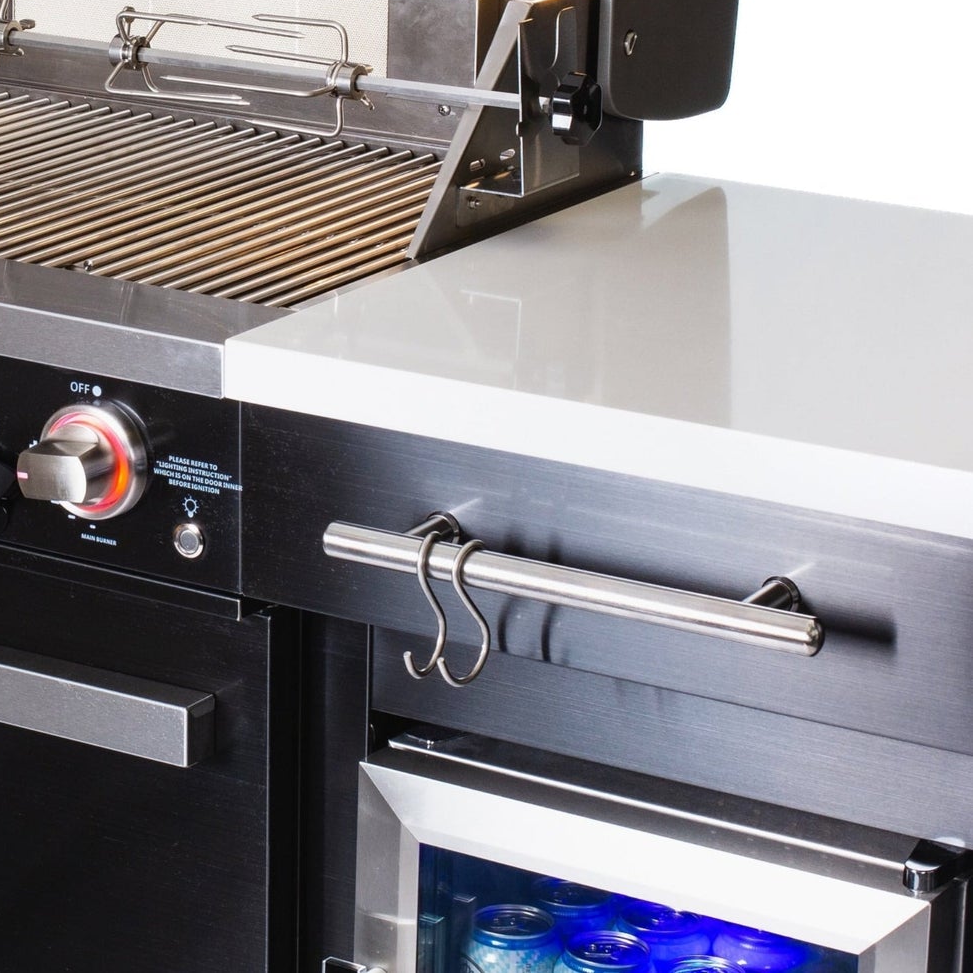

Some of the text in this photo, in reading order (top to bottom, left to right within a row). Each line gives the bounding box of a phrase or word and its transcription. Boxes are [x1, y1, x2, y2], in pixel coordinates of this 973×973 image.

[70, 382, 90, 394] OFF
[169, 456, 218, 471] PLEASE REFER TO
[154, 468, 174, 478] WHICH
[182, 473, 192, 481] ON
[193, 475, 204, 483] THE
[205, 478, 223, 487] DOOR
[223, 481, 243, 492] INNER
[169, 479, 220, 495] BEFORE IGNITION
[81, 533, 117, 546] MAIN BURNER
